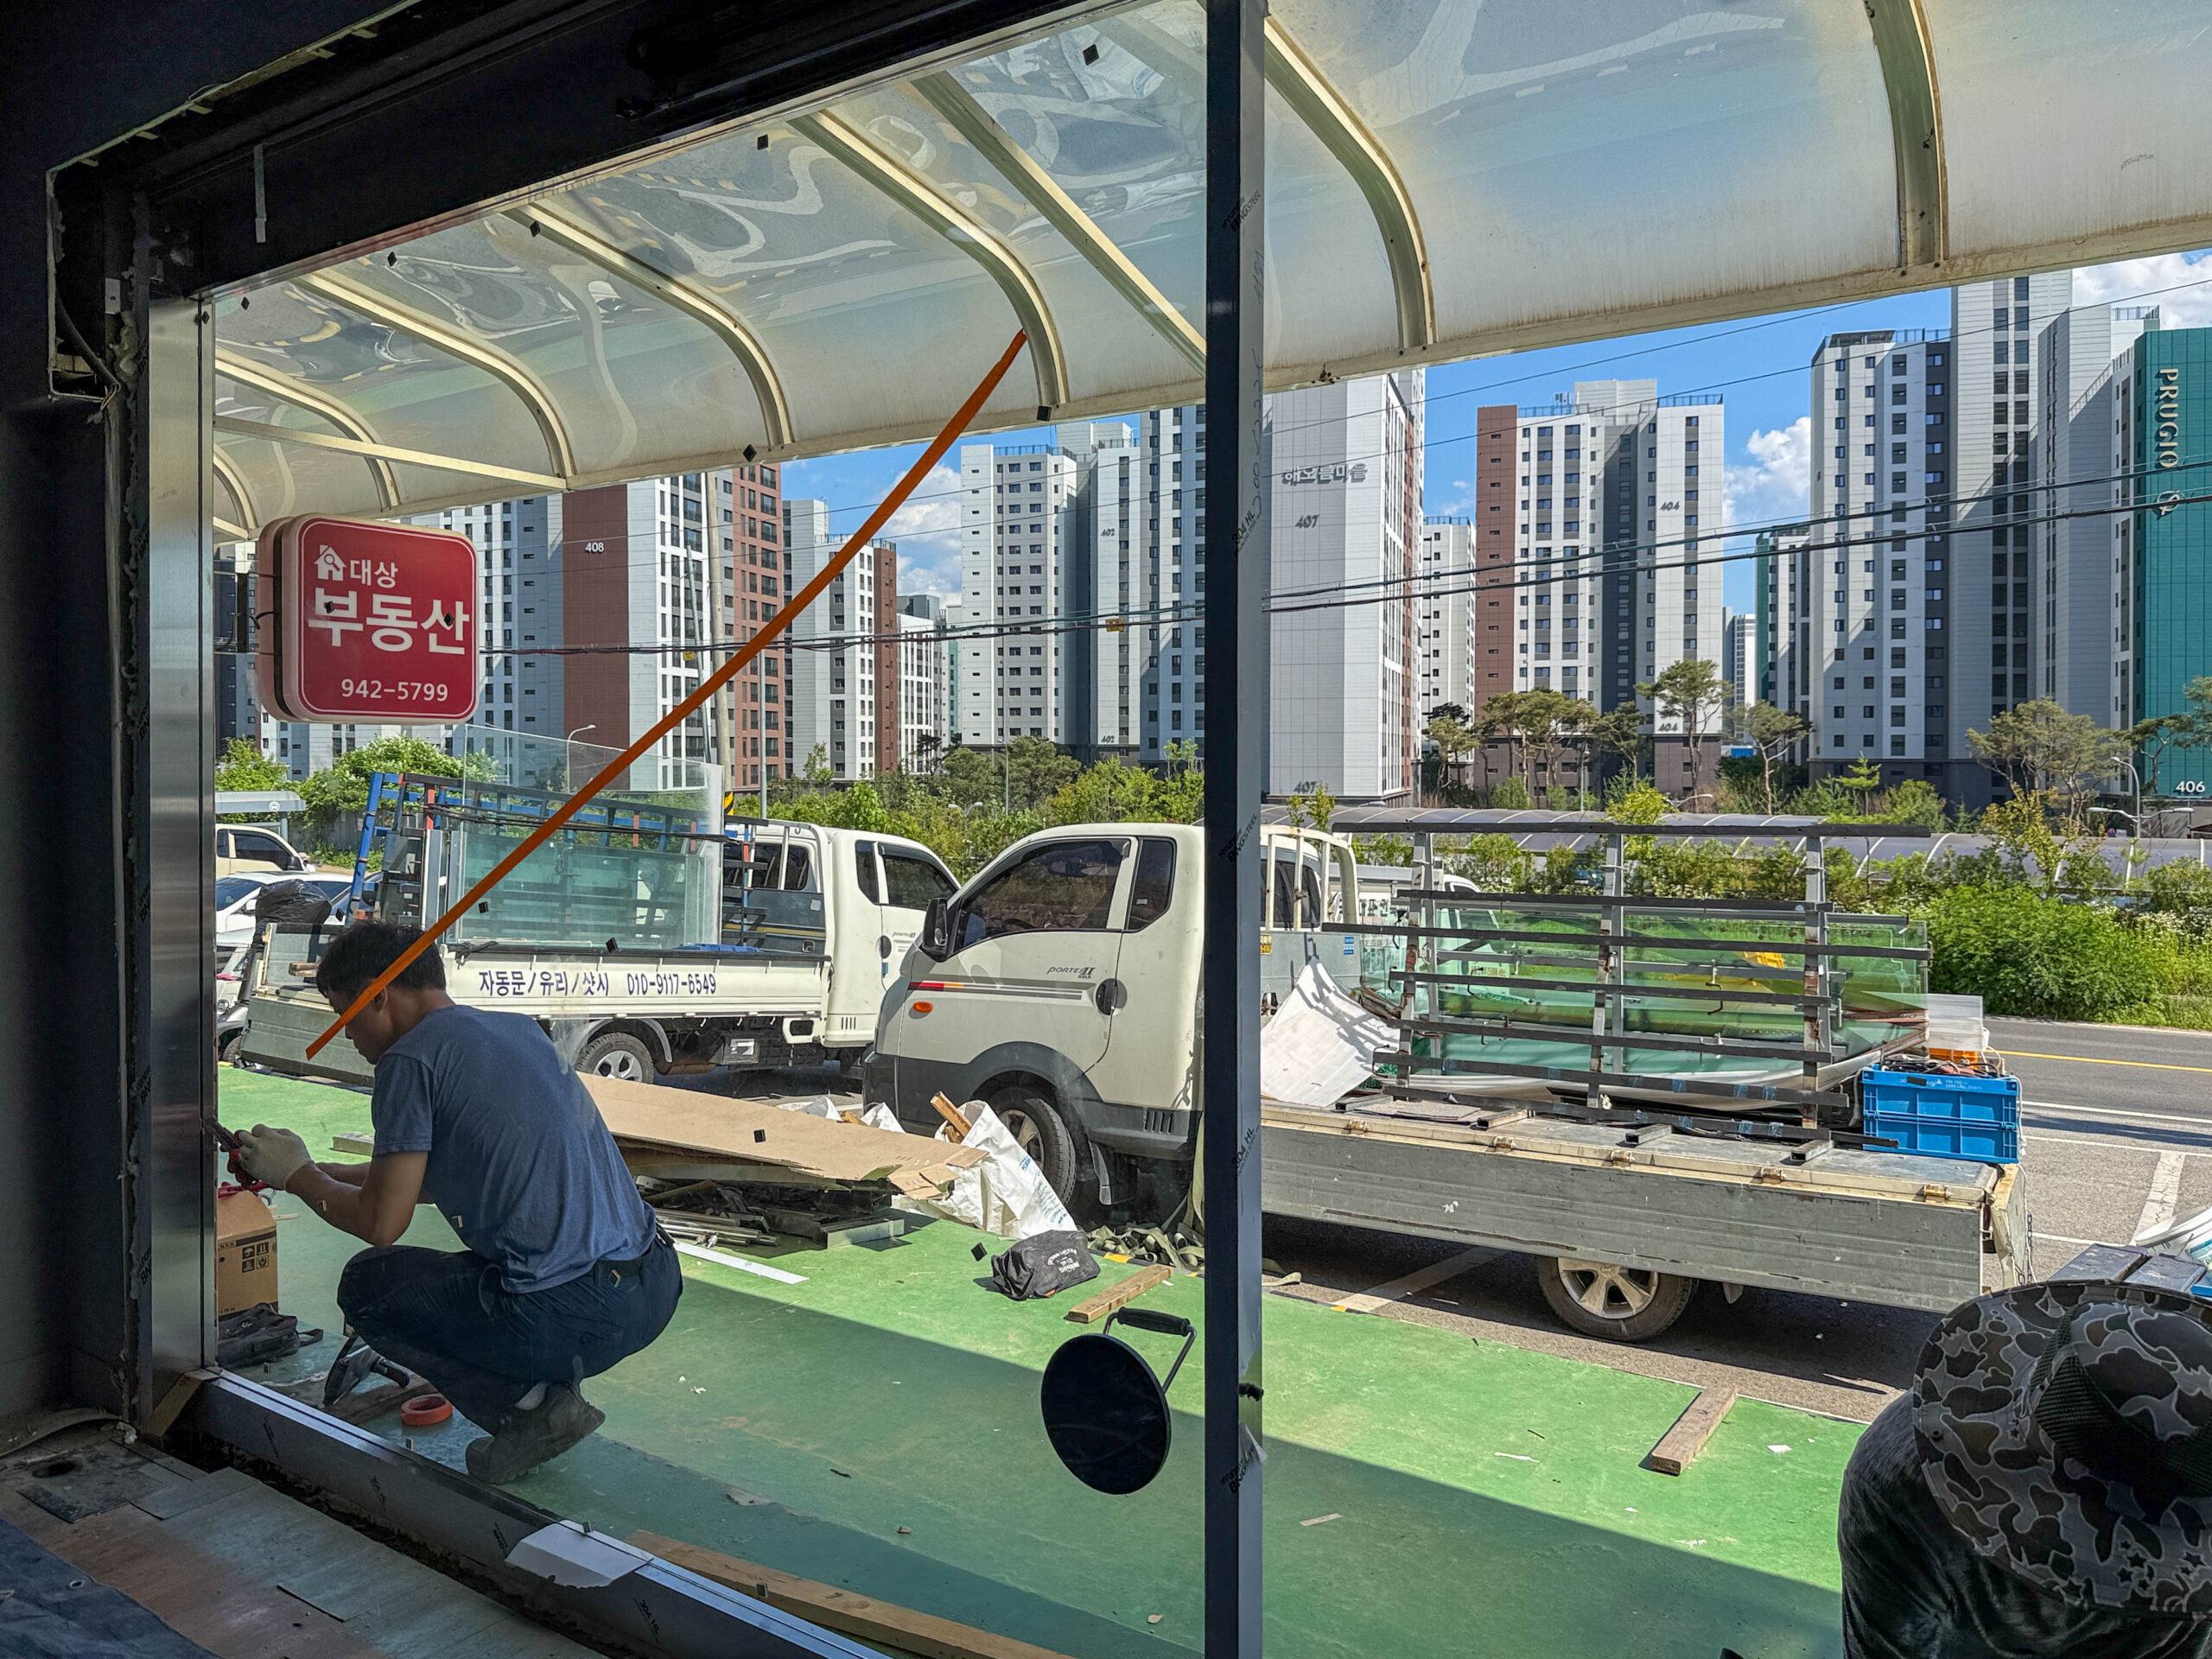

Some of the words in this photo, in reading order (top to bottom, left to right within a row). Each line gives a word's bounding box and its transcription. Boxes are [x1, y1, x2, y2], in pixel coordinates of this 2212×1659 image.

[2159, 368, 2178, 467] PRUGIO
[1660, 500, 1680, 511] 404
[1295, 514, 1320, 529] 407
[1101, 528, 1116, 537] 402
[585, 542, 604, 552] 408
[350, 559, 398, 588] 대상
[308, 588, 470, 655] 부동산
[341, 678, 448, 702] 942-5799
[1657, 722, 1678, 732] 404
[1294, 781, 1317, 793] 407
[2175, 780, 2205, 793] 406
[626, 973, 716, 996] 010-9117-6549
